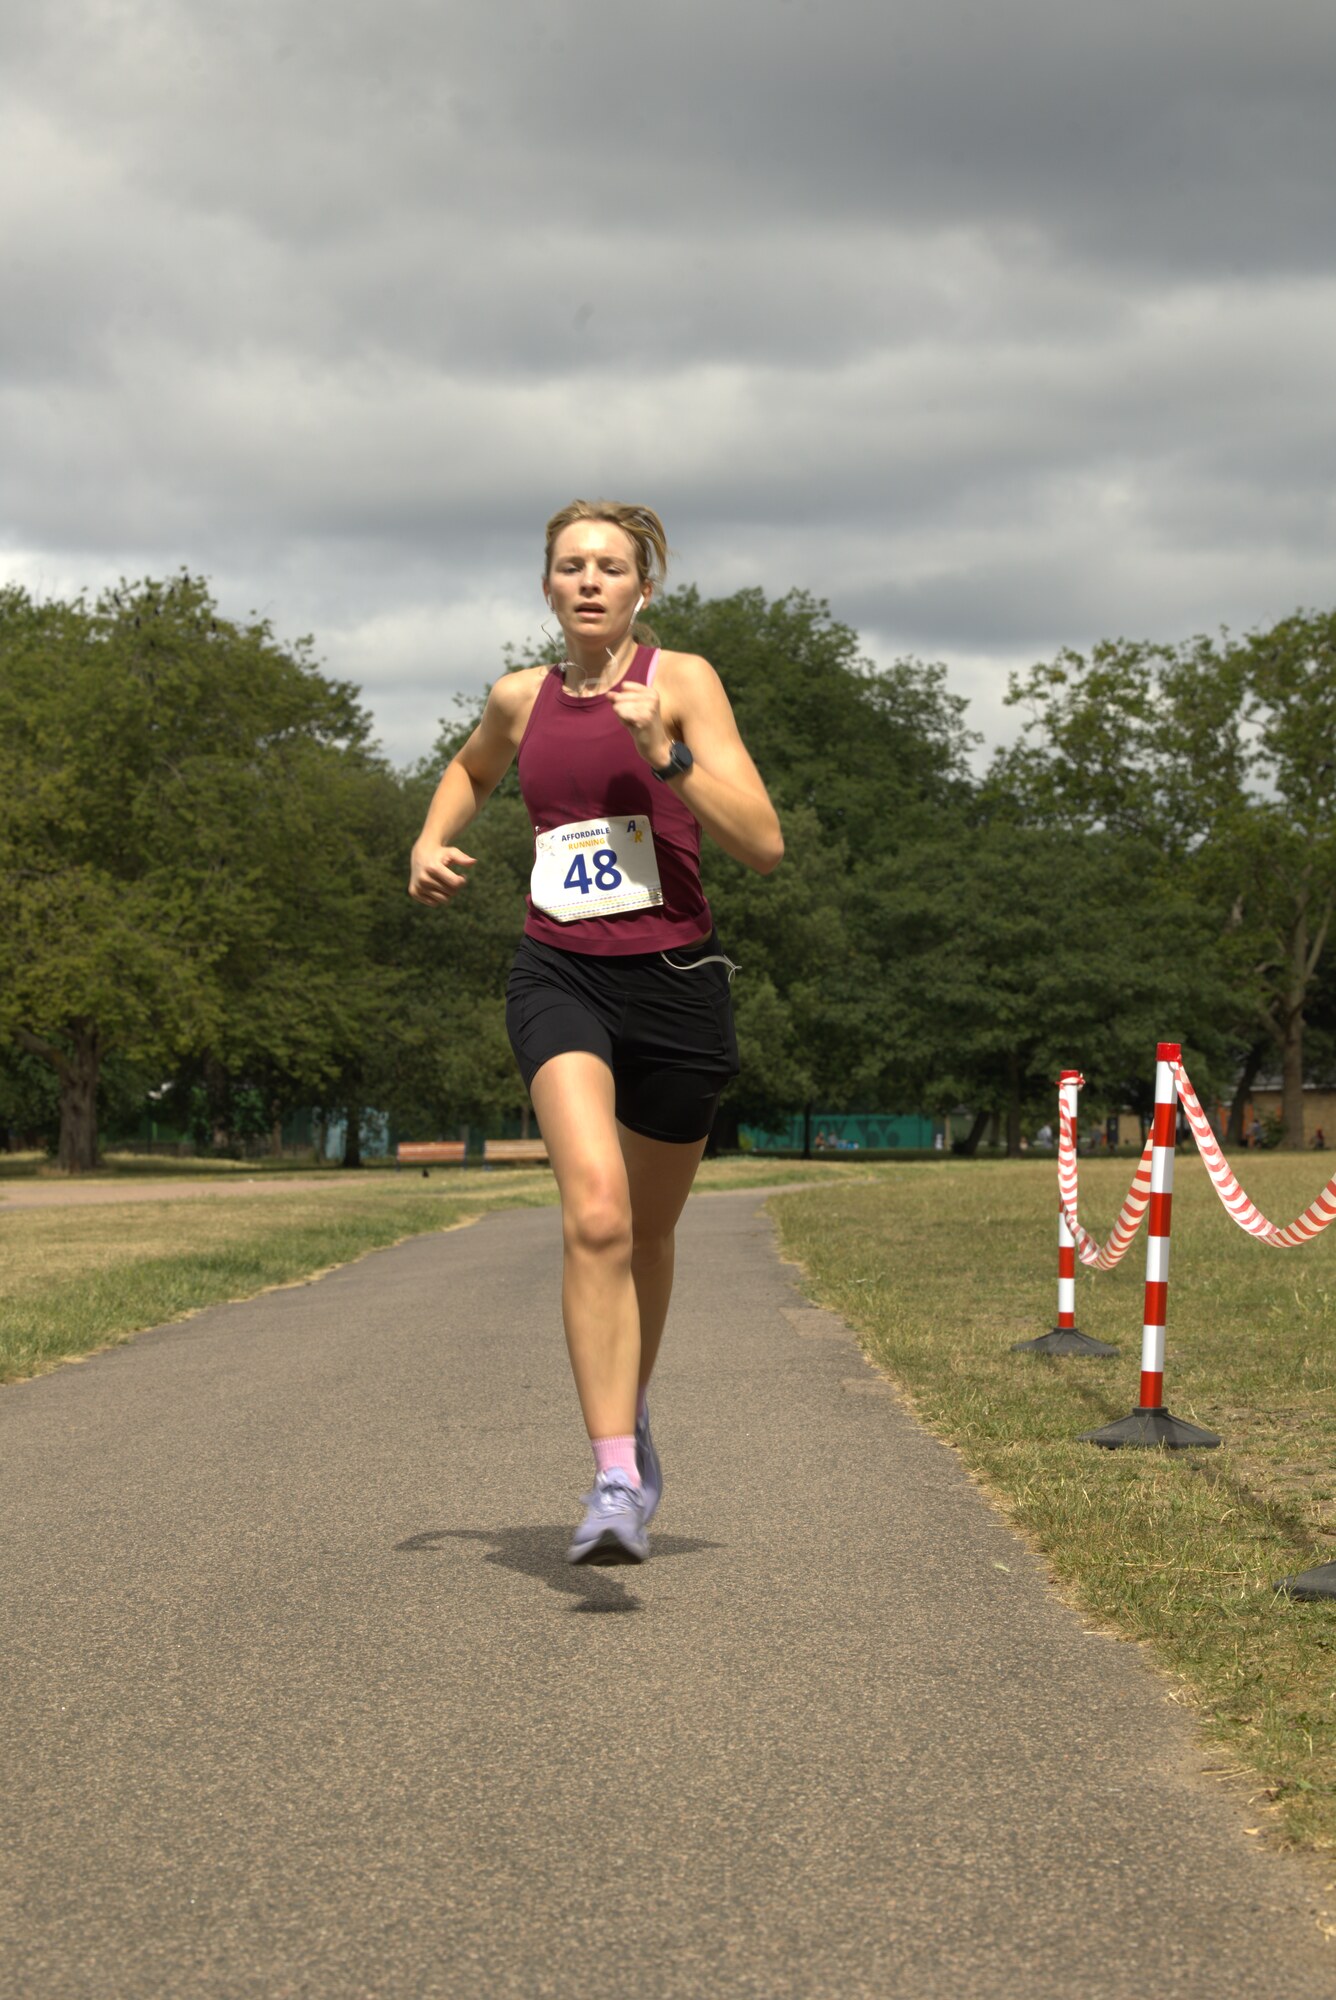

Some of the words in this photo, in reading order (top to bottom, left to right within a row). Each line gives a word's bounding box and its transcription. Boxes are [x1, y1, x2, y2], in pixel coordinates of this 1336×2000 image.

[561, 827, 611, 842] AFFORDABLE
[568, 838, 606, 850] RUNNING
[563, 849, 622, 894] 48
